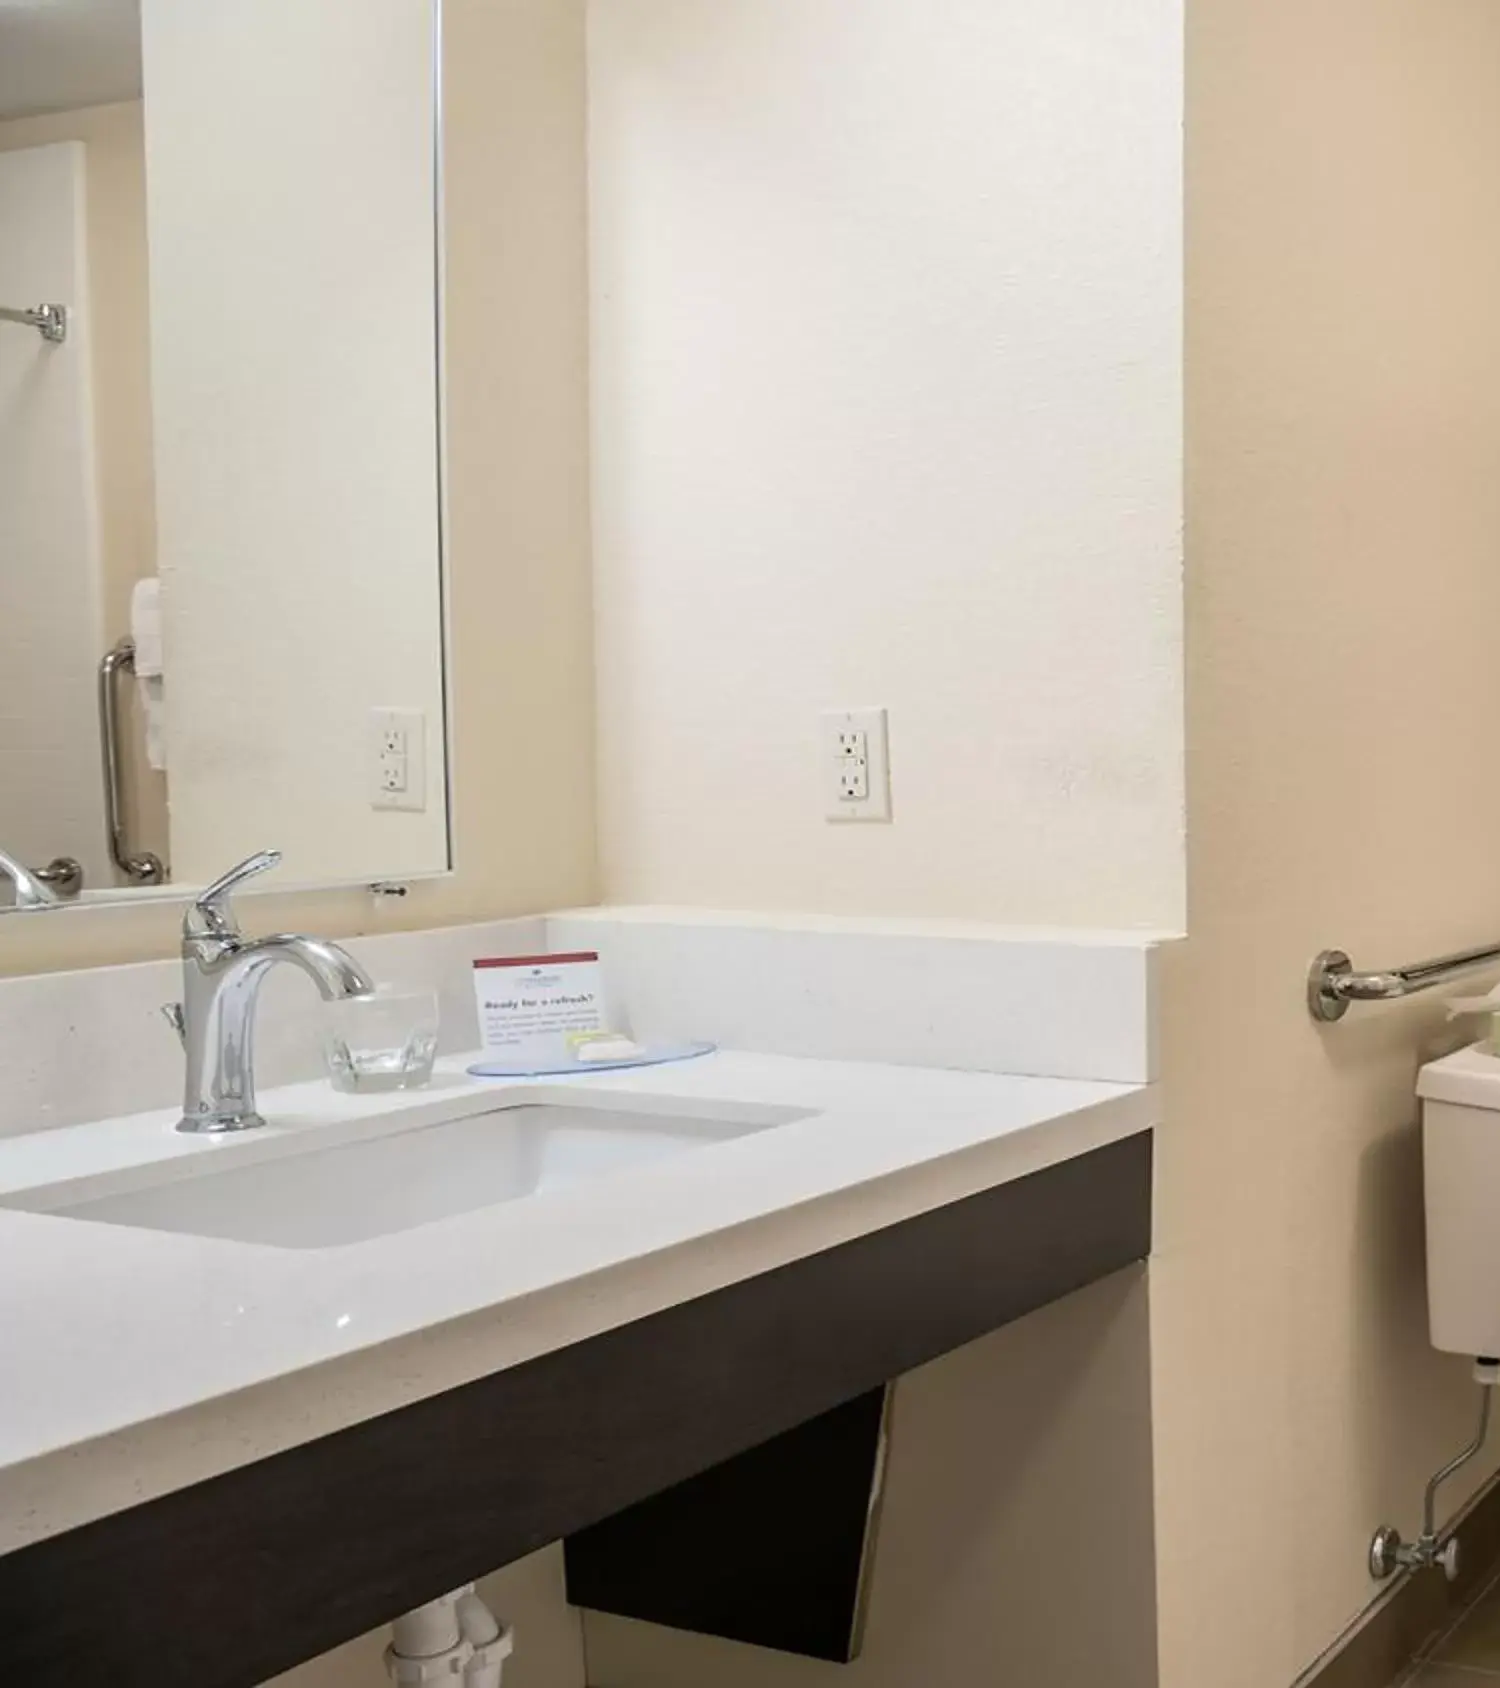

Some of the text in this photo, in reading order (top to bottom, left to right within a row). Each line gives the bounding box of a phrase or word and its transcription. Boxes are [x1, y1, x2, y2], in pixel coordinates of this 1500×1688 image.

[485, 1000, 518, 1011] Ready
[521, 997, 538, 1007] for
[550, 992, 594, 1005] refresh?
